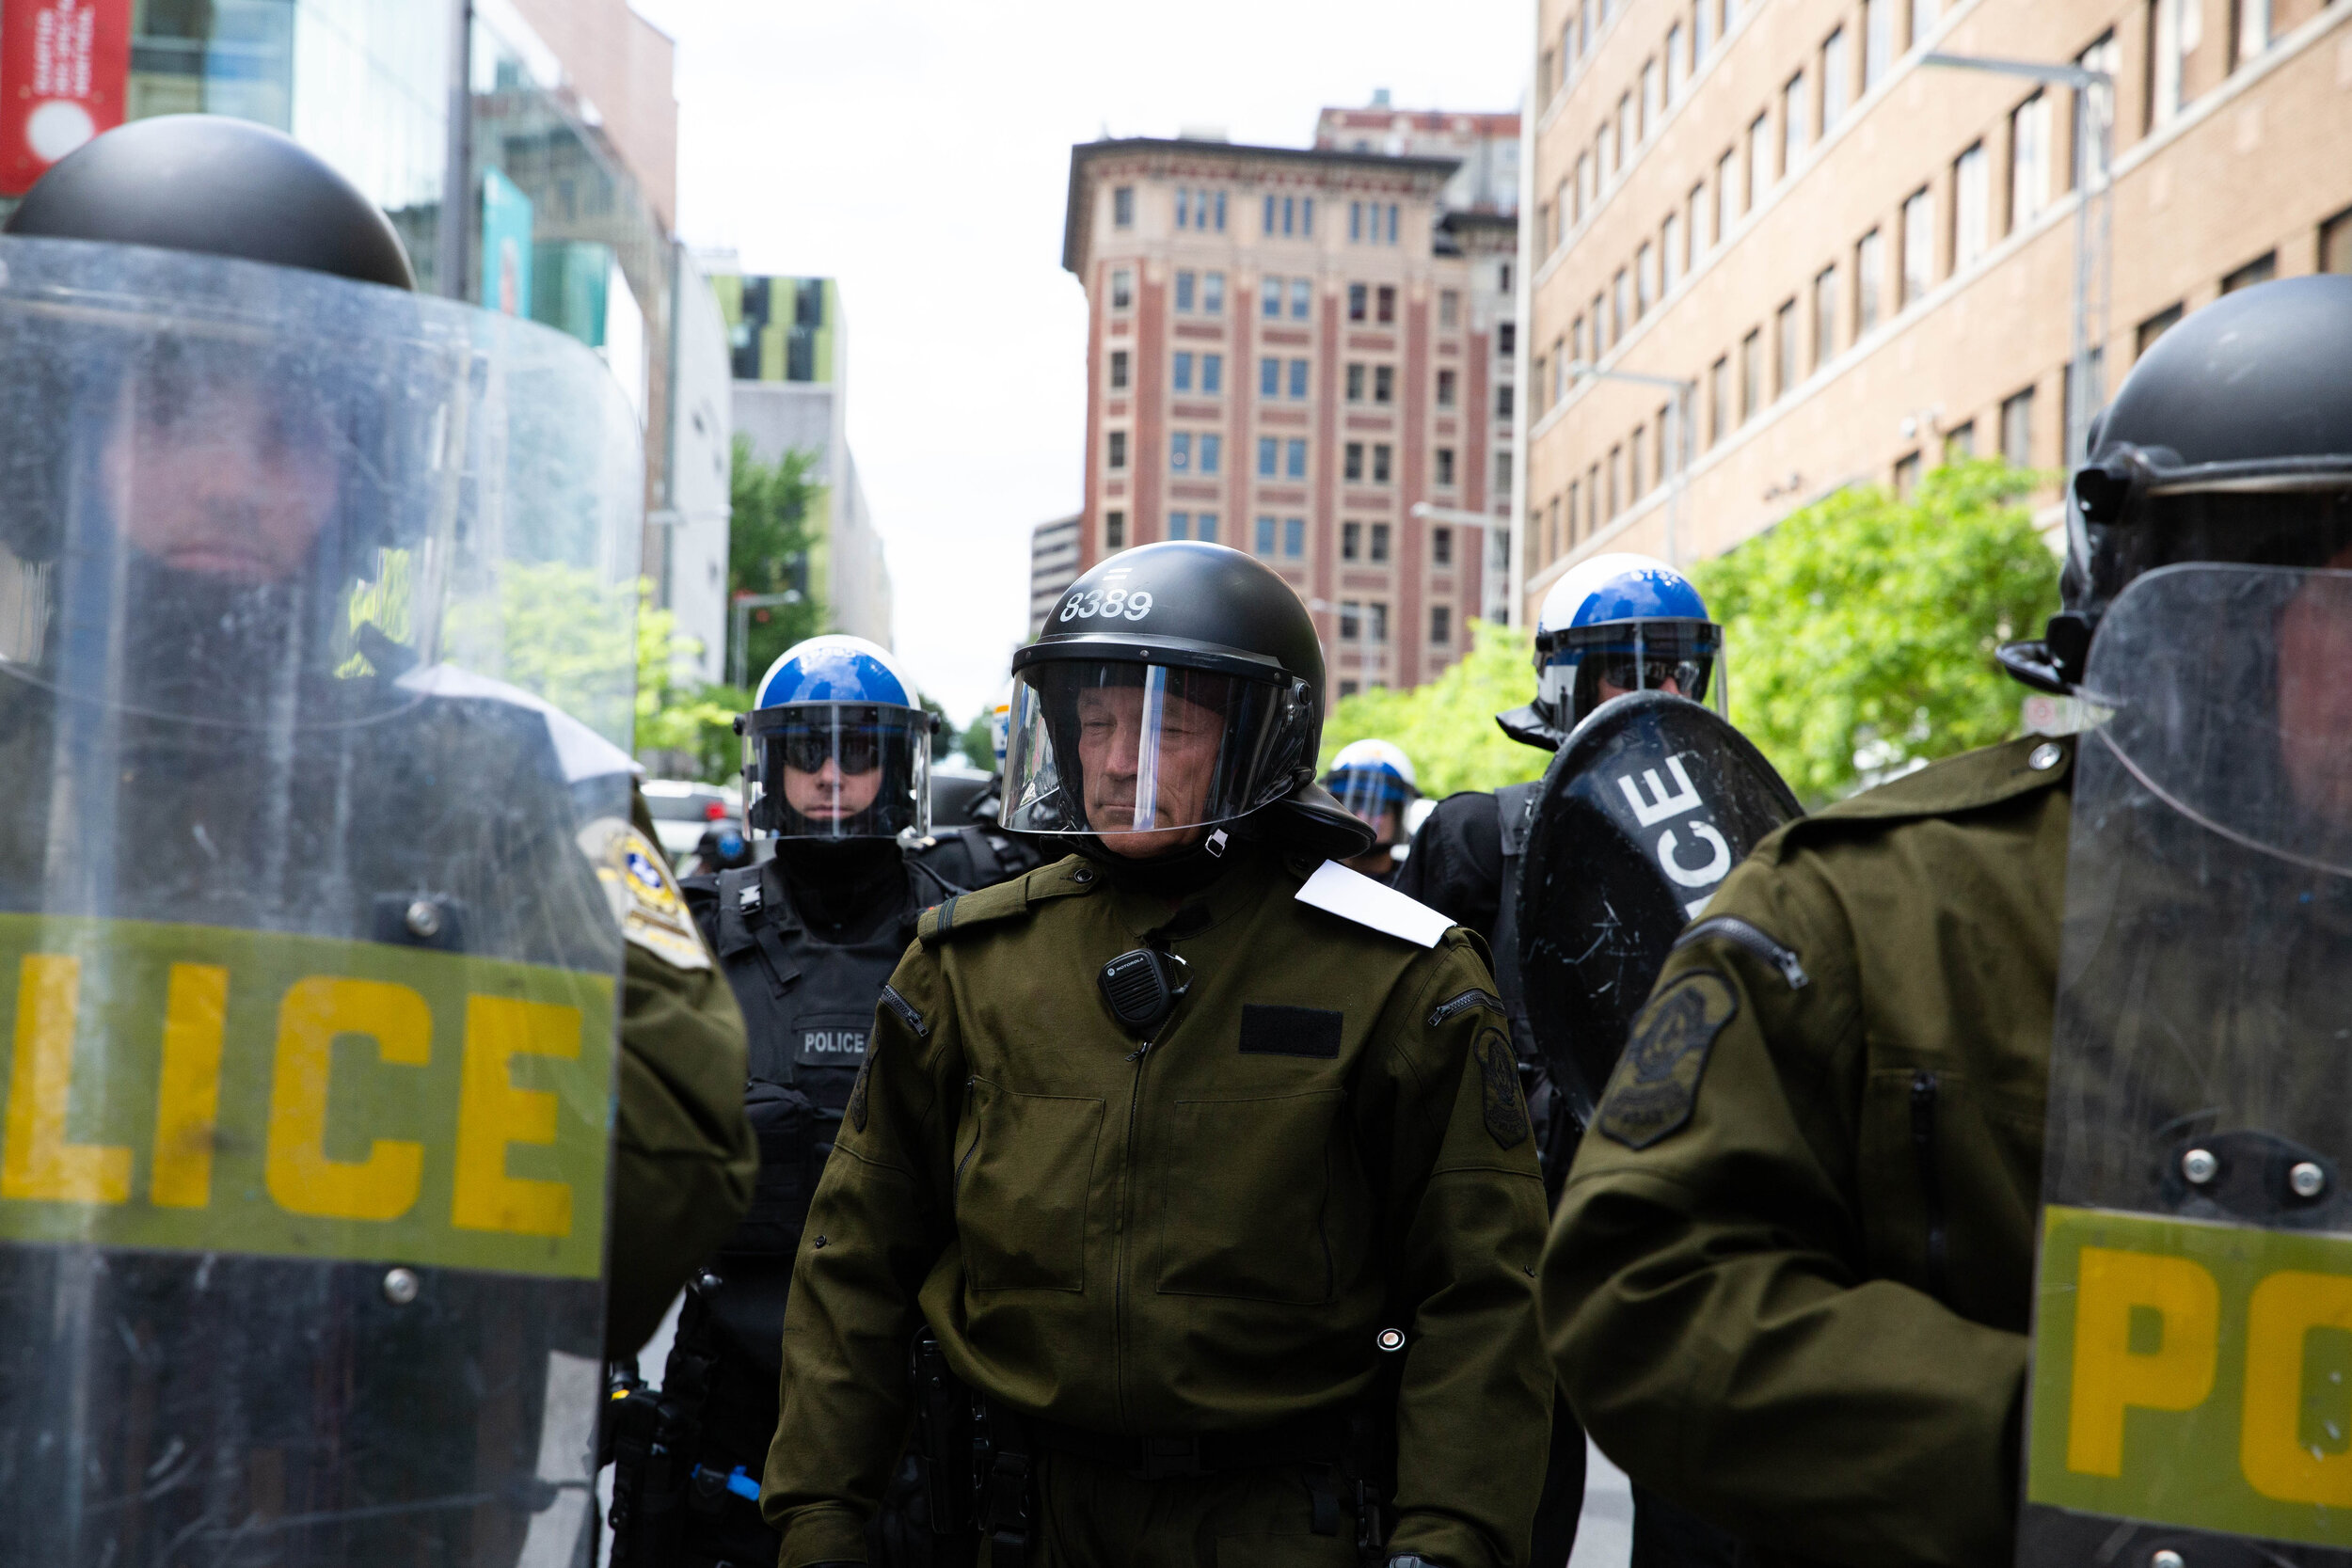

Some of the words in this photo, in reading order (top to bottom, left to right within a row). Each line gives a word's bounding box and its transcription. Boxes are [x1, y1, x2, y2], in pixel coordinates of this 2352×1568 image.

[1059, 588, 1152, 622] 8389
[1116, 957, 1144, 972] MOTOROLA
[804, 1031, 865, 1053] POLICE
[2, 954, 582, 1237] LICE
